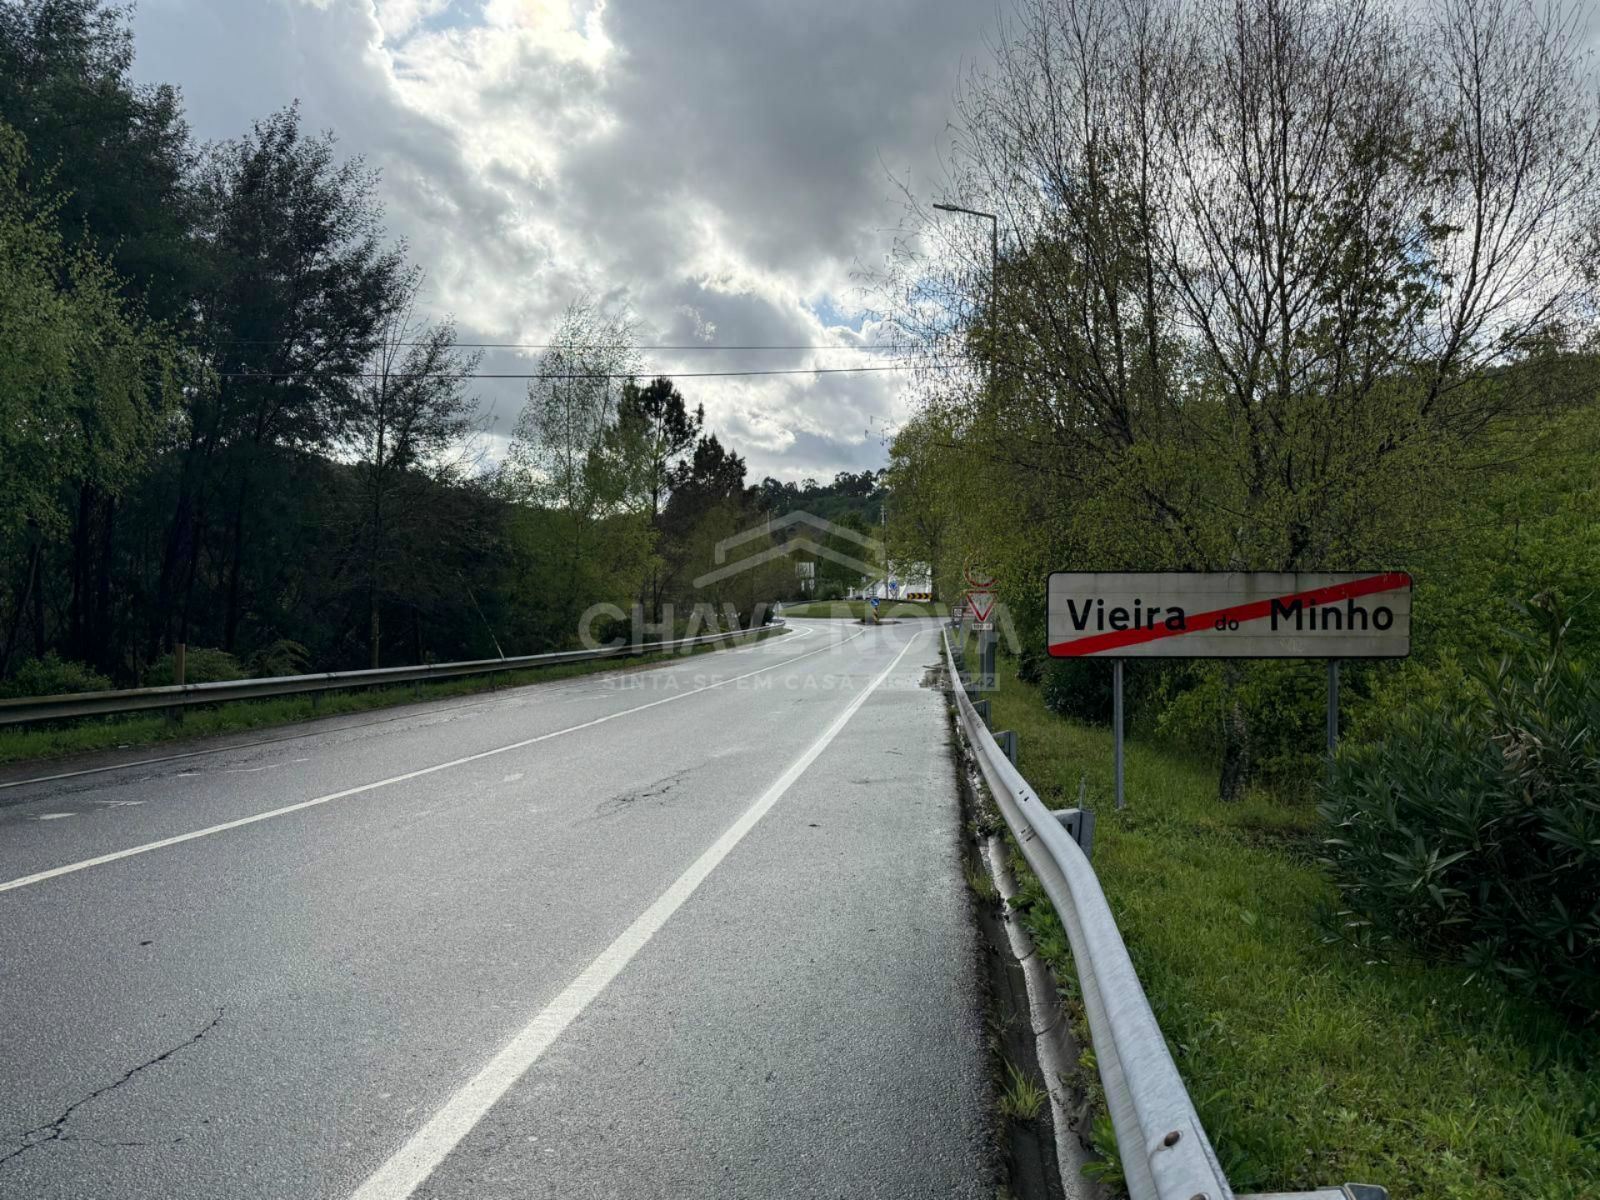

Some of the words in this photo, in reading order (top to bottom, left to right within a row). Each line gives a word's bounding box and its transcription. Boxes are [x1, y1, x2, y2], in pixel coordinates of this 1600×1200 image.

[1067, 598, 1186, 631] Vieira
[1214, 615, 1240, 631] do
[1270, 598, 1394, 631] Minho
